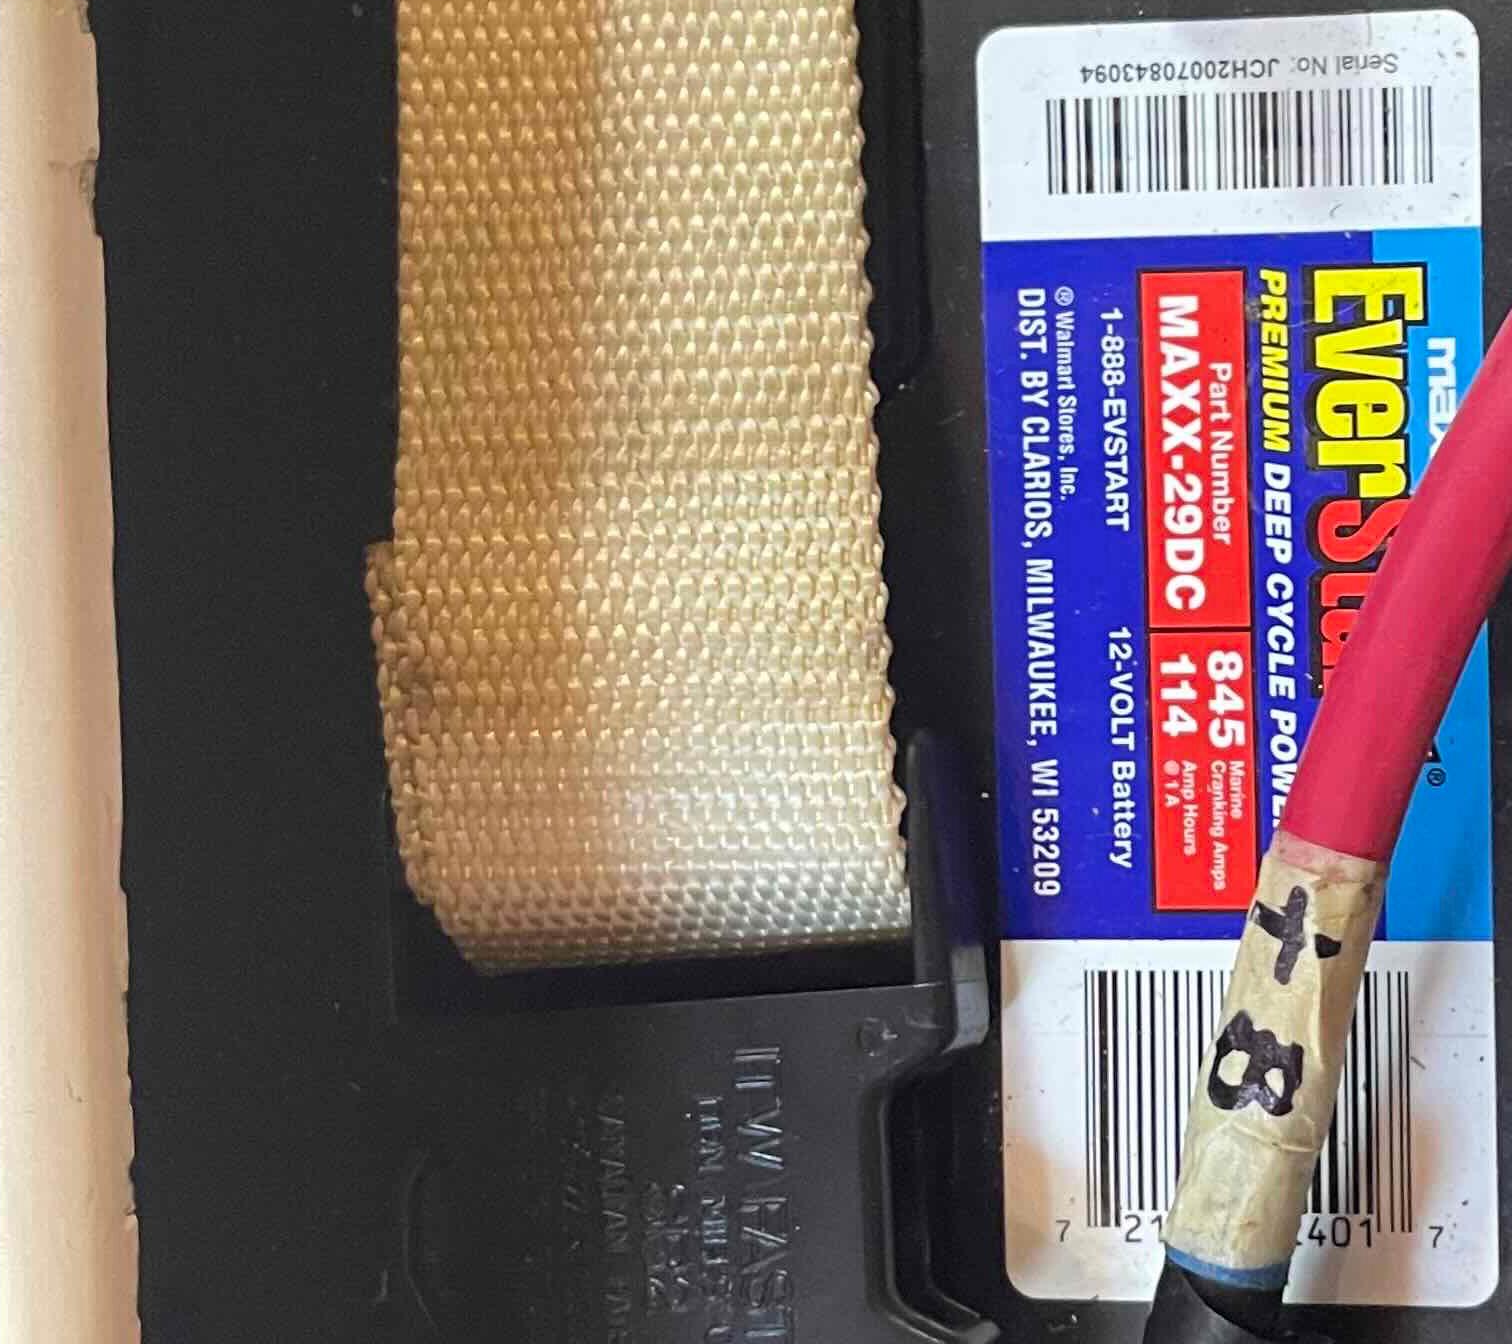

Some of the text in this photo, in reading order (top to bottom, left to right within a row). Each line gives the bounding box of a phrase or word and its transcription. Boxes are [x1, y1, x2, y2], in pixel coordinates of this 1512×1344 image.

[1080, 53, 1399, 84] Serial No: JCH20070843094
[1055, 311, 1076, 391] Walmart
[1057, 394, 1078, 461] Stores,
[1100, 307, 1130, 532] 1-888-EVSTART
[1157, 294, 1207, 612] MAXX-29DC
[1208, 362, 1235, 546] Part Number
[1059, 467, 1079, 501] Inc.
[1314, 265, 1424, 693] EverSt
[1017, 288, 1061, 896] DIST. BY CLARIOS, MILWAUKEE, WI 53209
[1259, 269, 1298, 828] PREMIUM DEEP CYCLE POWE
[1160, 653, 1198, 738] 114
[1207, 650, 1246, 749] 845
[1108, 627, 1136, 869] 12-VOLT Battery
[1229, 760, 1245, 819] Marine
[1182, 759, 1198, 856] Amp Hours
[1210, 760, 1229, 891] Cranking Amps
[1055, 1220, 1071, 1242] 7
[1296, 1216, 1373, 1248] 401
[1428, 1226, 1444, 1248] 7
